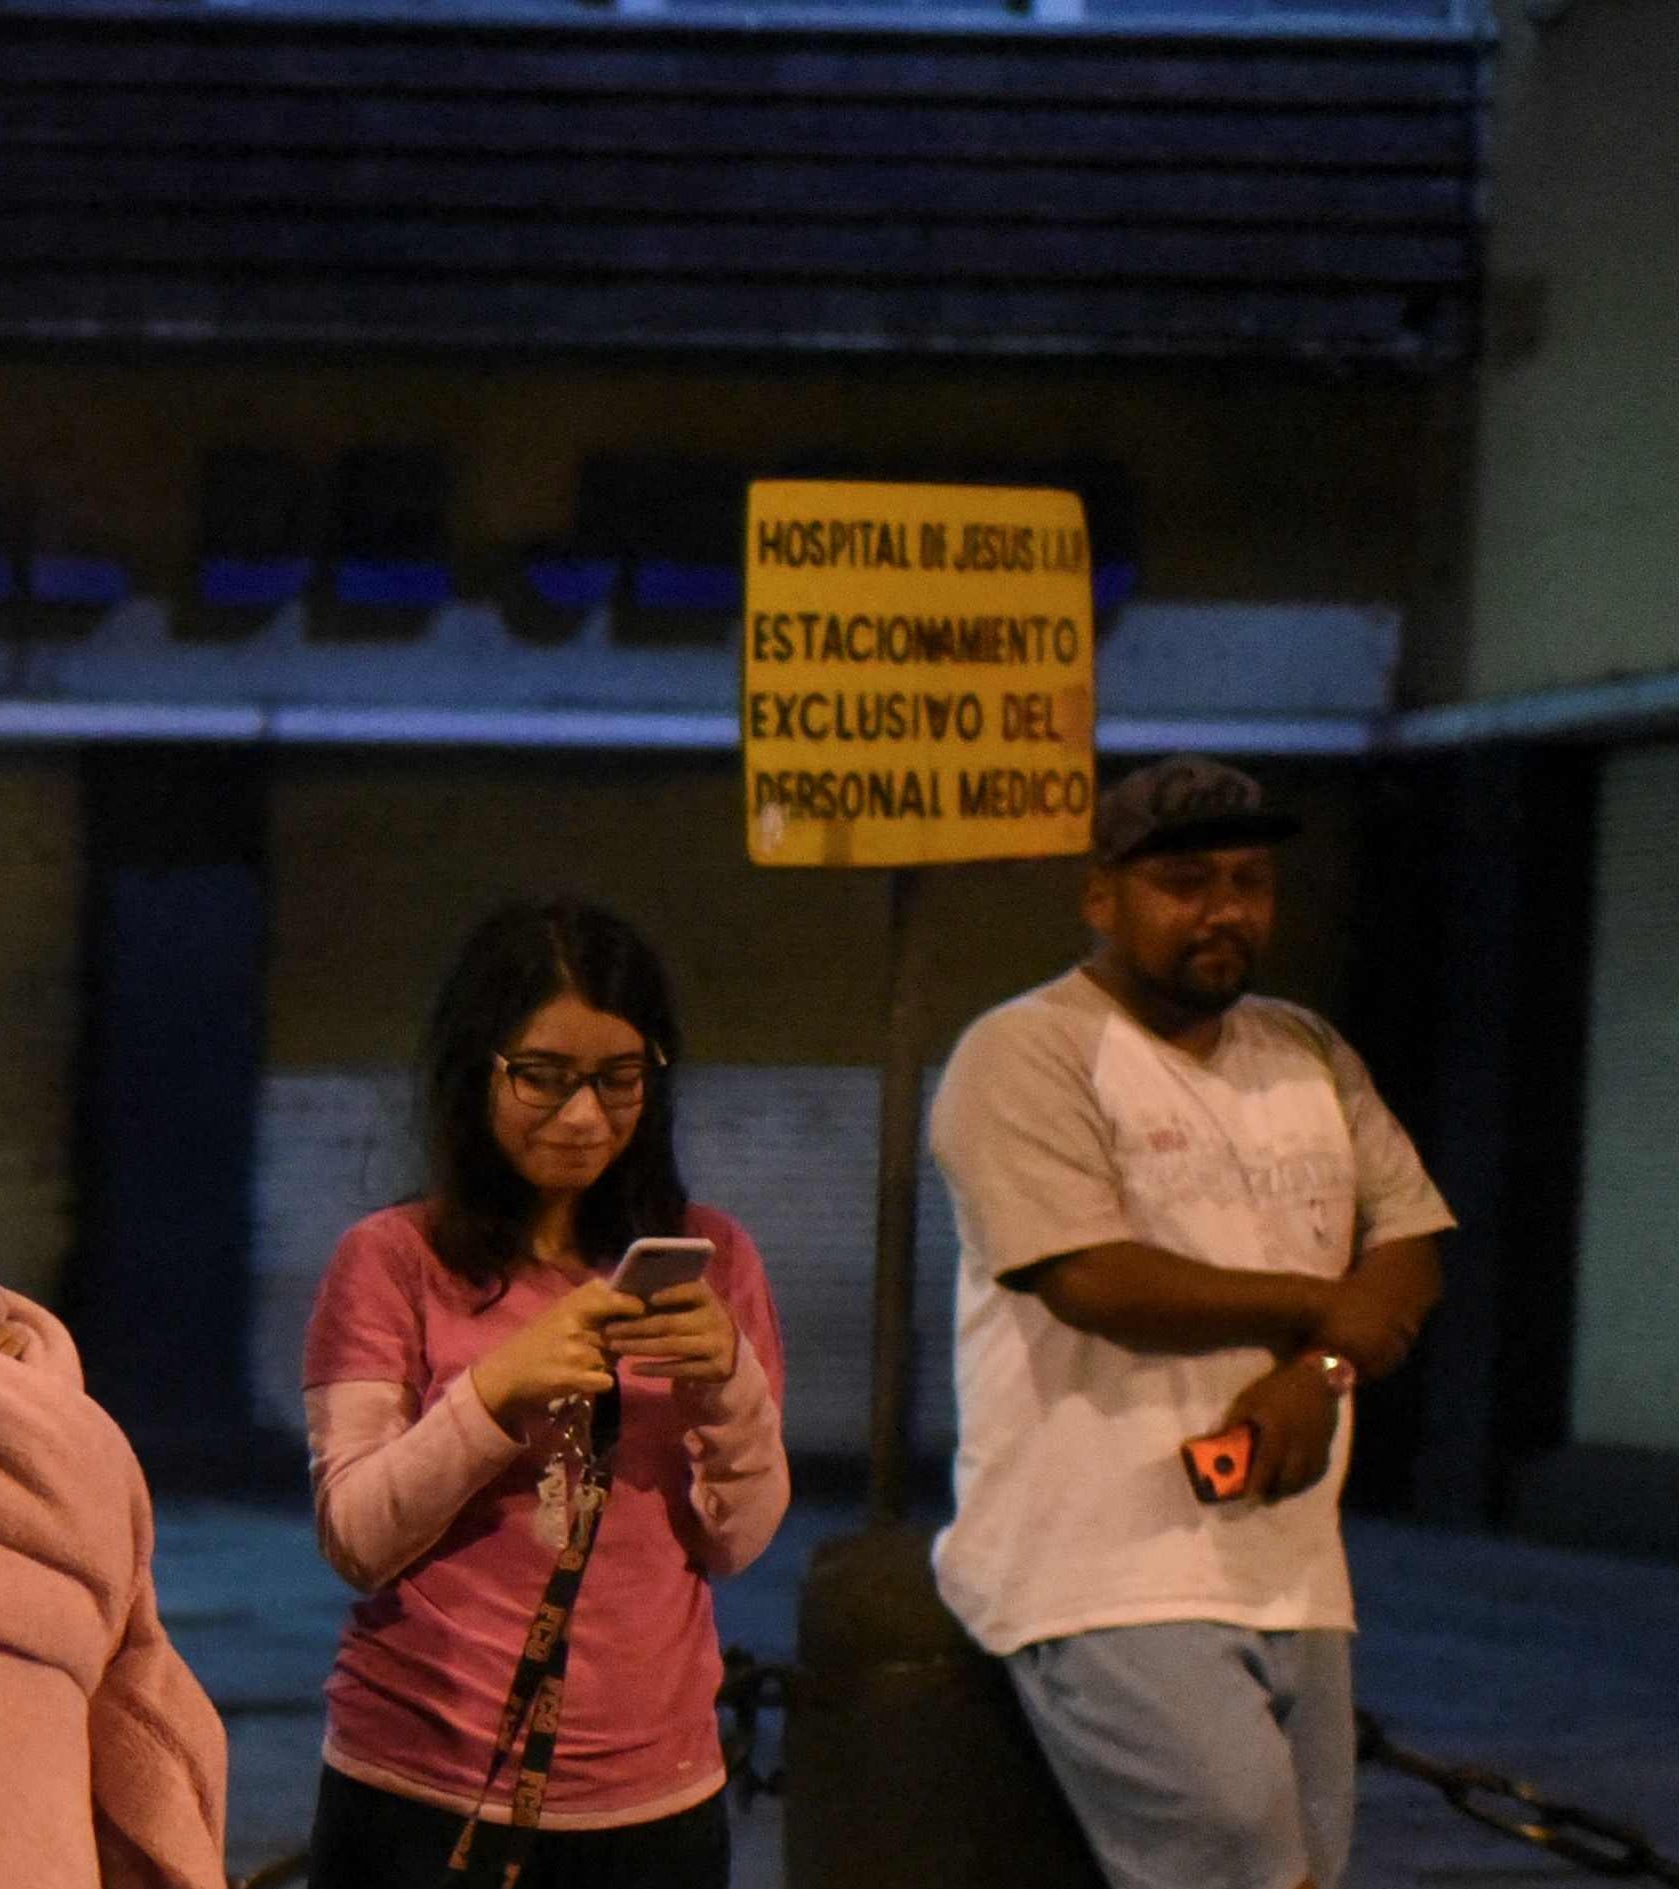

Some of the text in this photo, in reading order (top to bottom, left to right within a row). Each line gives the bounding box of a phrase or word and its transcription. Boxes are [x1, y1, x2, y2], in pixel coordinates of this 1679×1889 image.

[757, 519, 911, 571] HOSPITAL
[953, 522, 1035, 573] JESUS
[753, 612, 1079, 664] ESTACIONAMIENTO
[750, 691, 1062, 743] EXCLUSIVO DEL
[754, 769, 1089, 820] PERSONAL MEDICO
